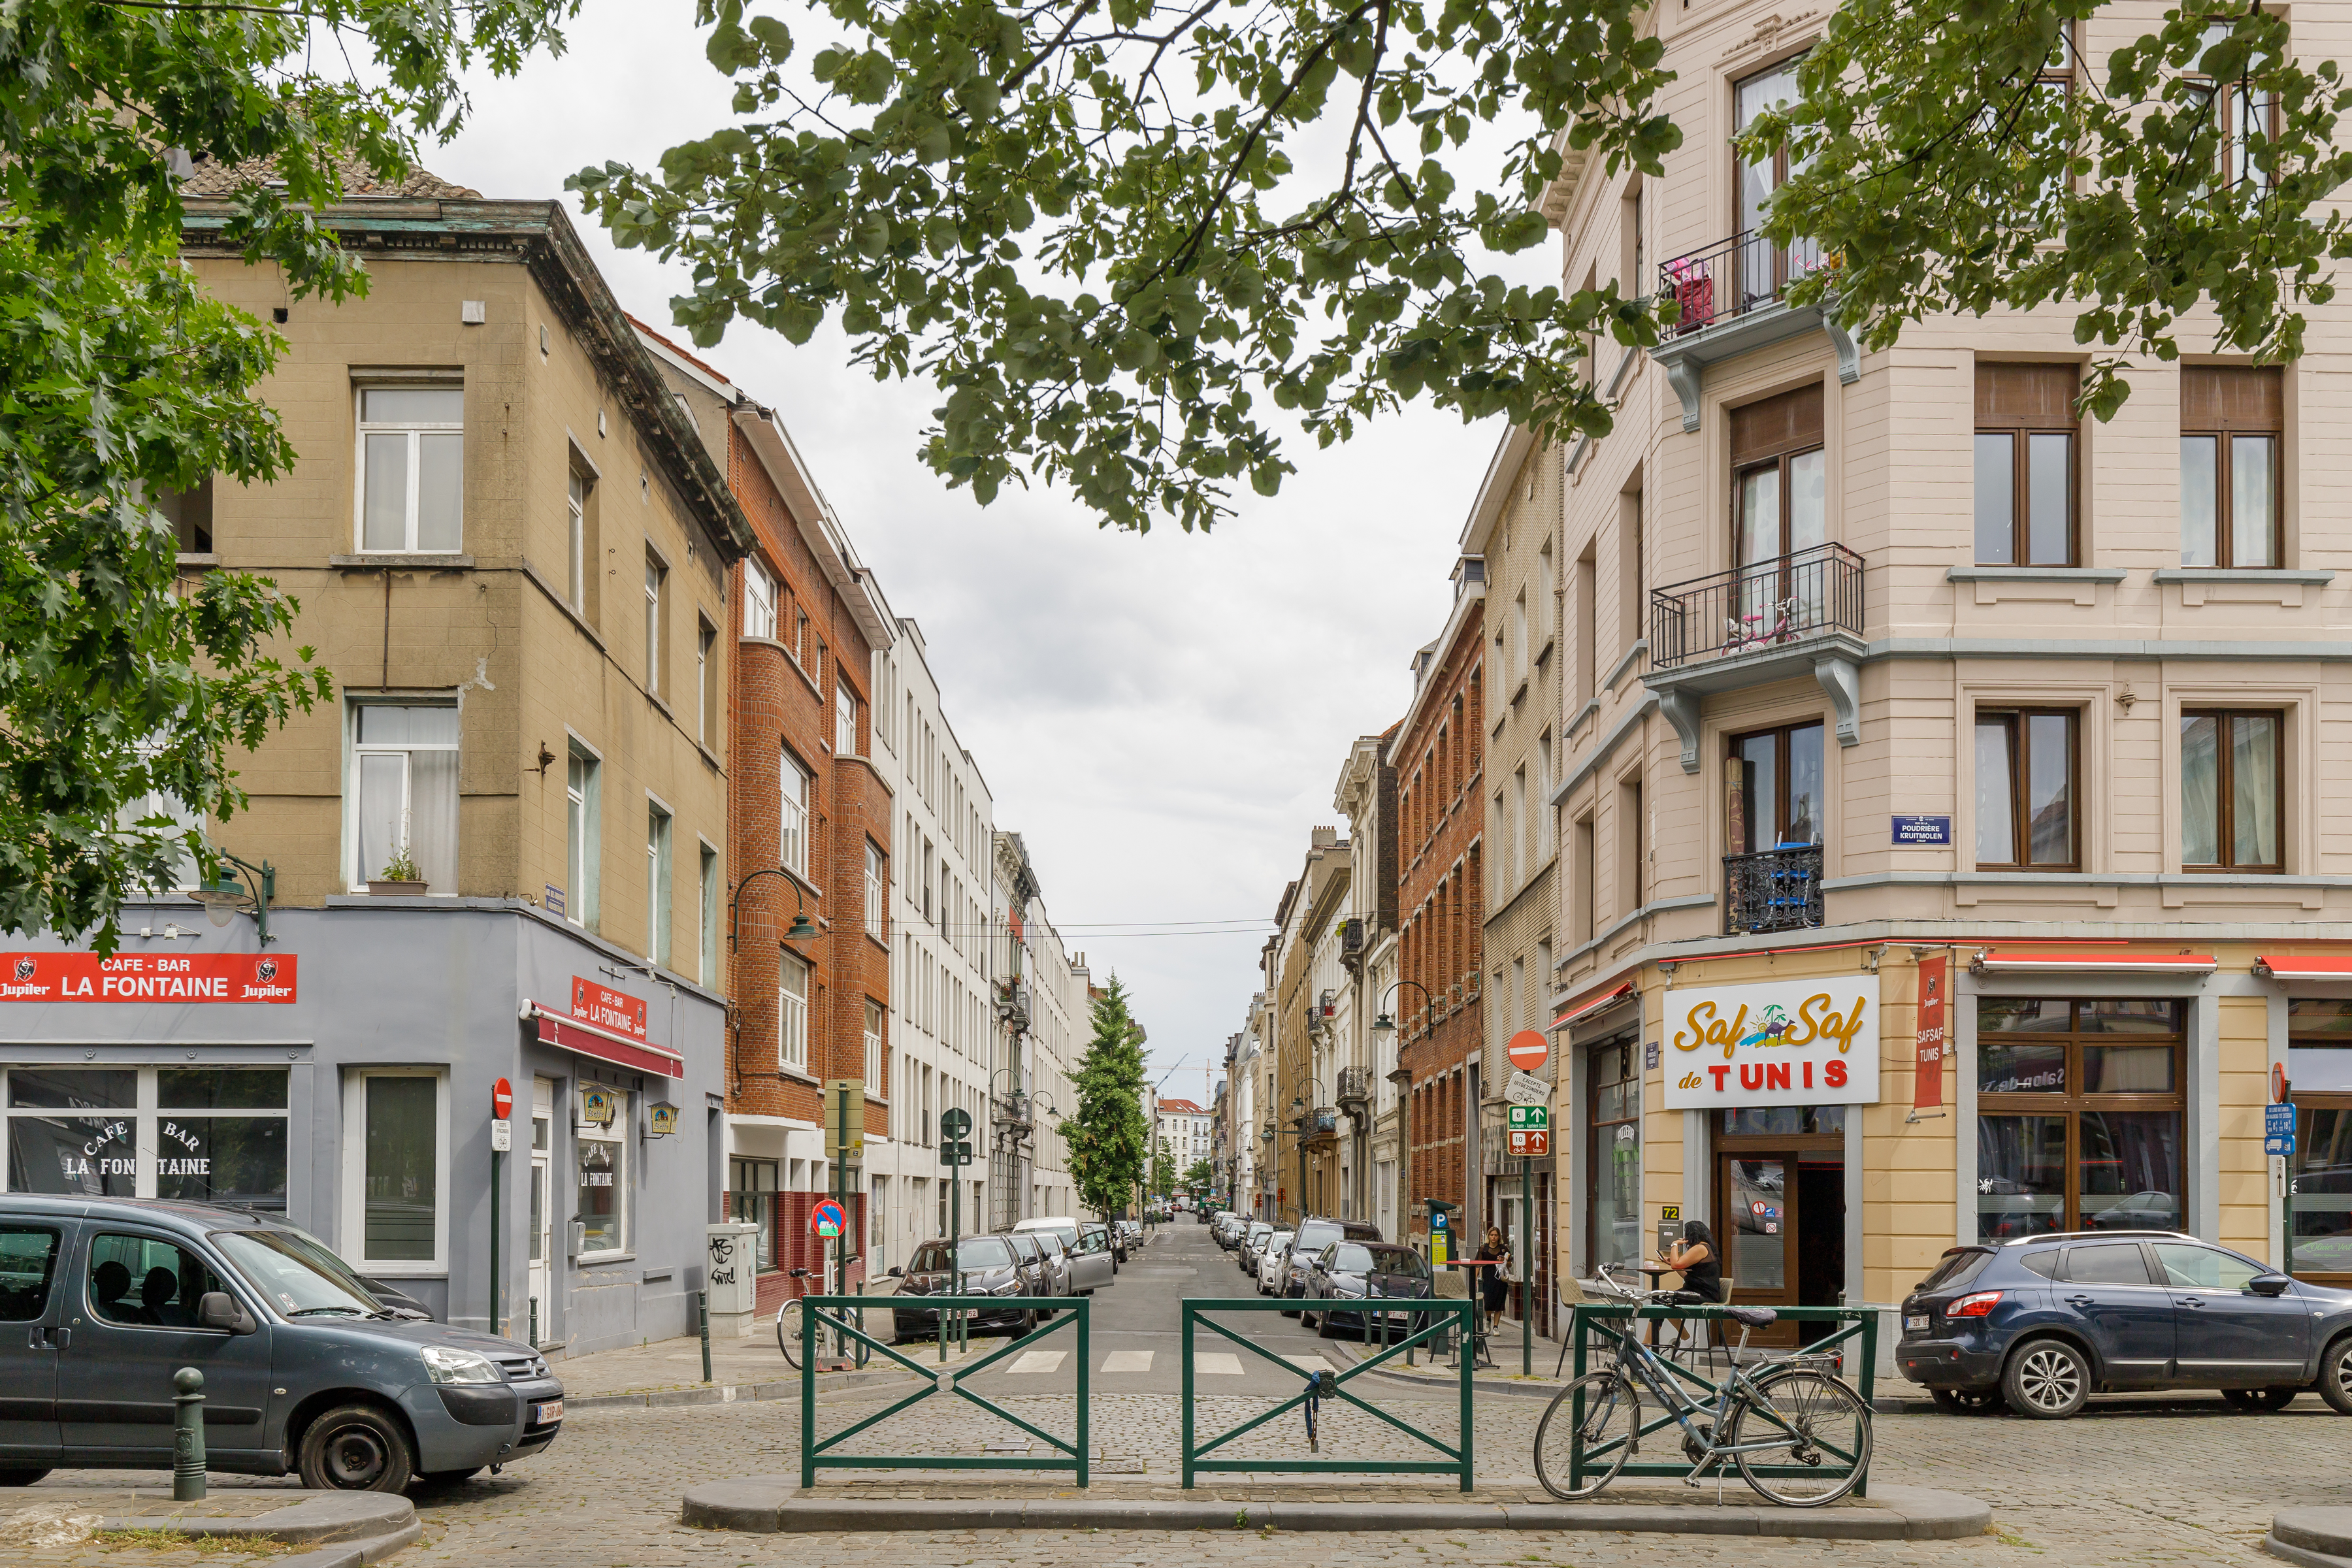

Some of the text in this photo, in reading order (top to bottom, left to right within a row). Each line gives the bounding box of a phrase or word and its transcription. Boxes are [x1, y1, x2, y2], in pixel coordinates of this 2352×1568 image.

[101, 958, 144, 972] CAFE
[157, 959, 190, 972] BAR
[0, 983, 50, 998] Jupiler
[61, 977, 228, 997] LA FONTAINE
[240, 985, 292, 999] Jupiler
[600, 990, 612, 1005] CAFE
[614, 996, 623, 1009] BAR
[1923, 998, 1939, 1008] Jupiler
[573, 1005, 588, 1019] Jupiler
[590, 1004, 632, 1032] LA FONTAINE
[633, 1023, 645, 1036] Jupiler
[1673, 992, 1866, 1059] Saf Saf
[1917, 1026, 1944, 1044] SAFSAF
[1919, 1047, 1939, 1062] TUNIS
[1522, 1077, 1542, 1088] EXCEPTE
[1678, 1059, 1848, 1092] de TUNIS
[1514, 1080, 1545, 1096] UITGEZONDERD
[587, 1109, 604, 1119] Leffe
[653, 1122, 669, 1131] Leffe
[2273, 1122, 2276, 1130] 8
[2284, 1121, 2289, 1130] 18
[84, 1121, 199, 1156] CAFE BAR
[1617, 1124, 1635, 1143] PIZZERIA
[584, 1143, 610, 1168] CAFE BAR
[67, 1158, 90, 1175] LA
[581, 1172, 613, 1186] LA FONTAINE
[1436, 1213, 1446, 1227] P
[1663, 1207, 1678, 1218] 72
[1639, 1367, 1671, 1405] NORTA
